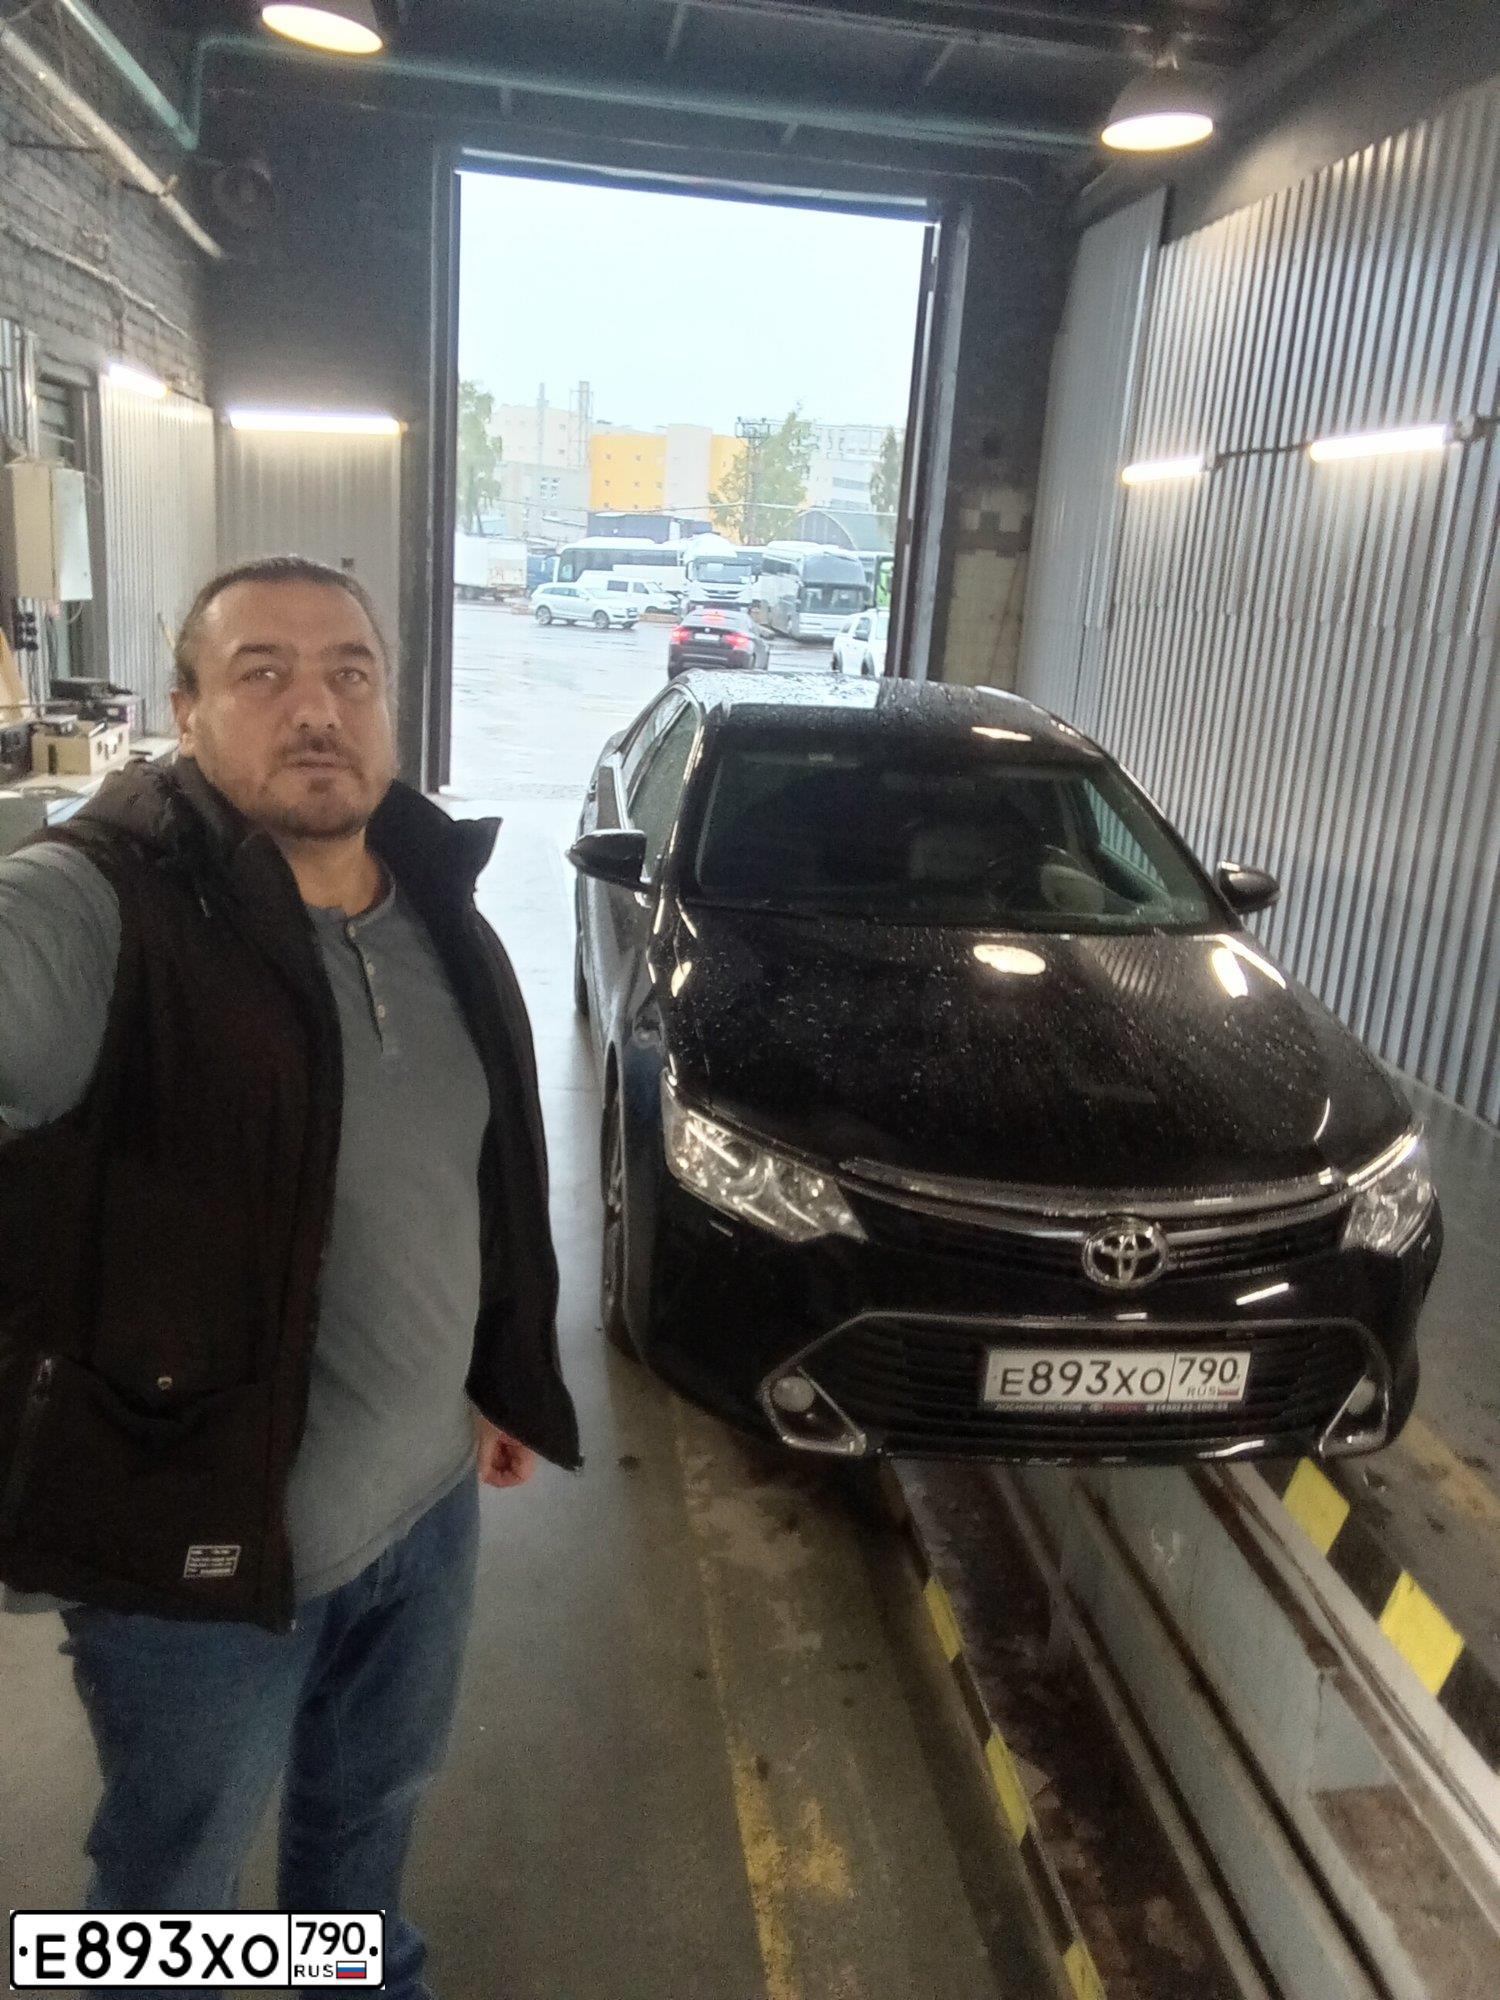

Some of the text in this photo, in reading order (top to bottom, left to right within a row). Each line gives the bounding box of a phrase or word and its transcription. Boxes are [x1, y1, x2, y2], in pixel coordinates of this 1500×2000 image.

[999, 1357, 1239, 1396] E893XO 790
[1186, 1386, 1216, 1396] RUS
